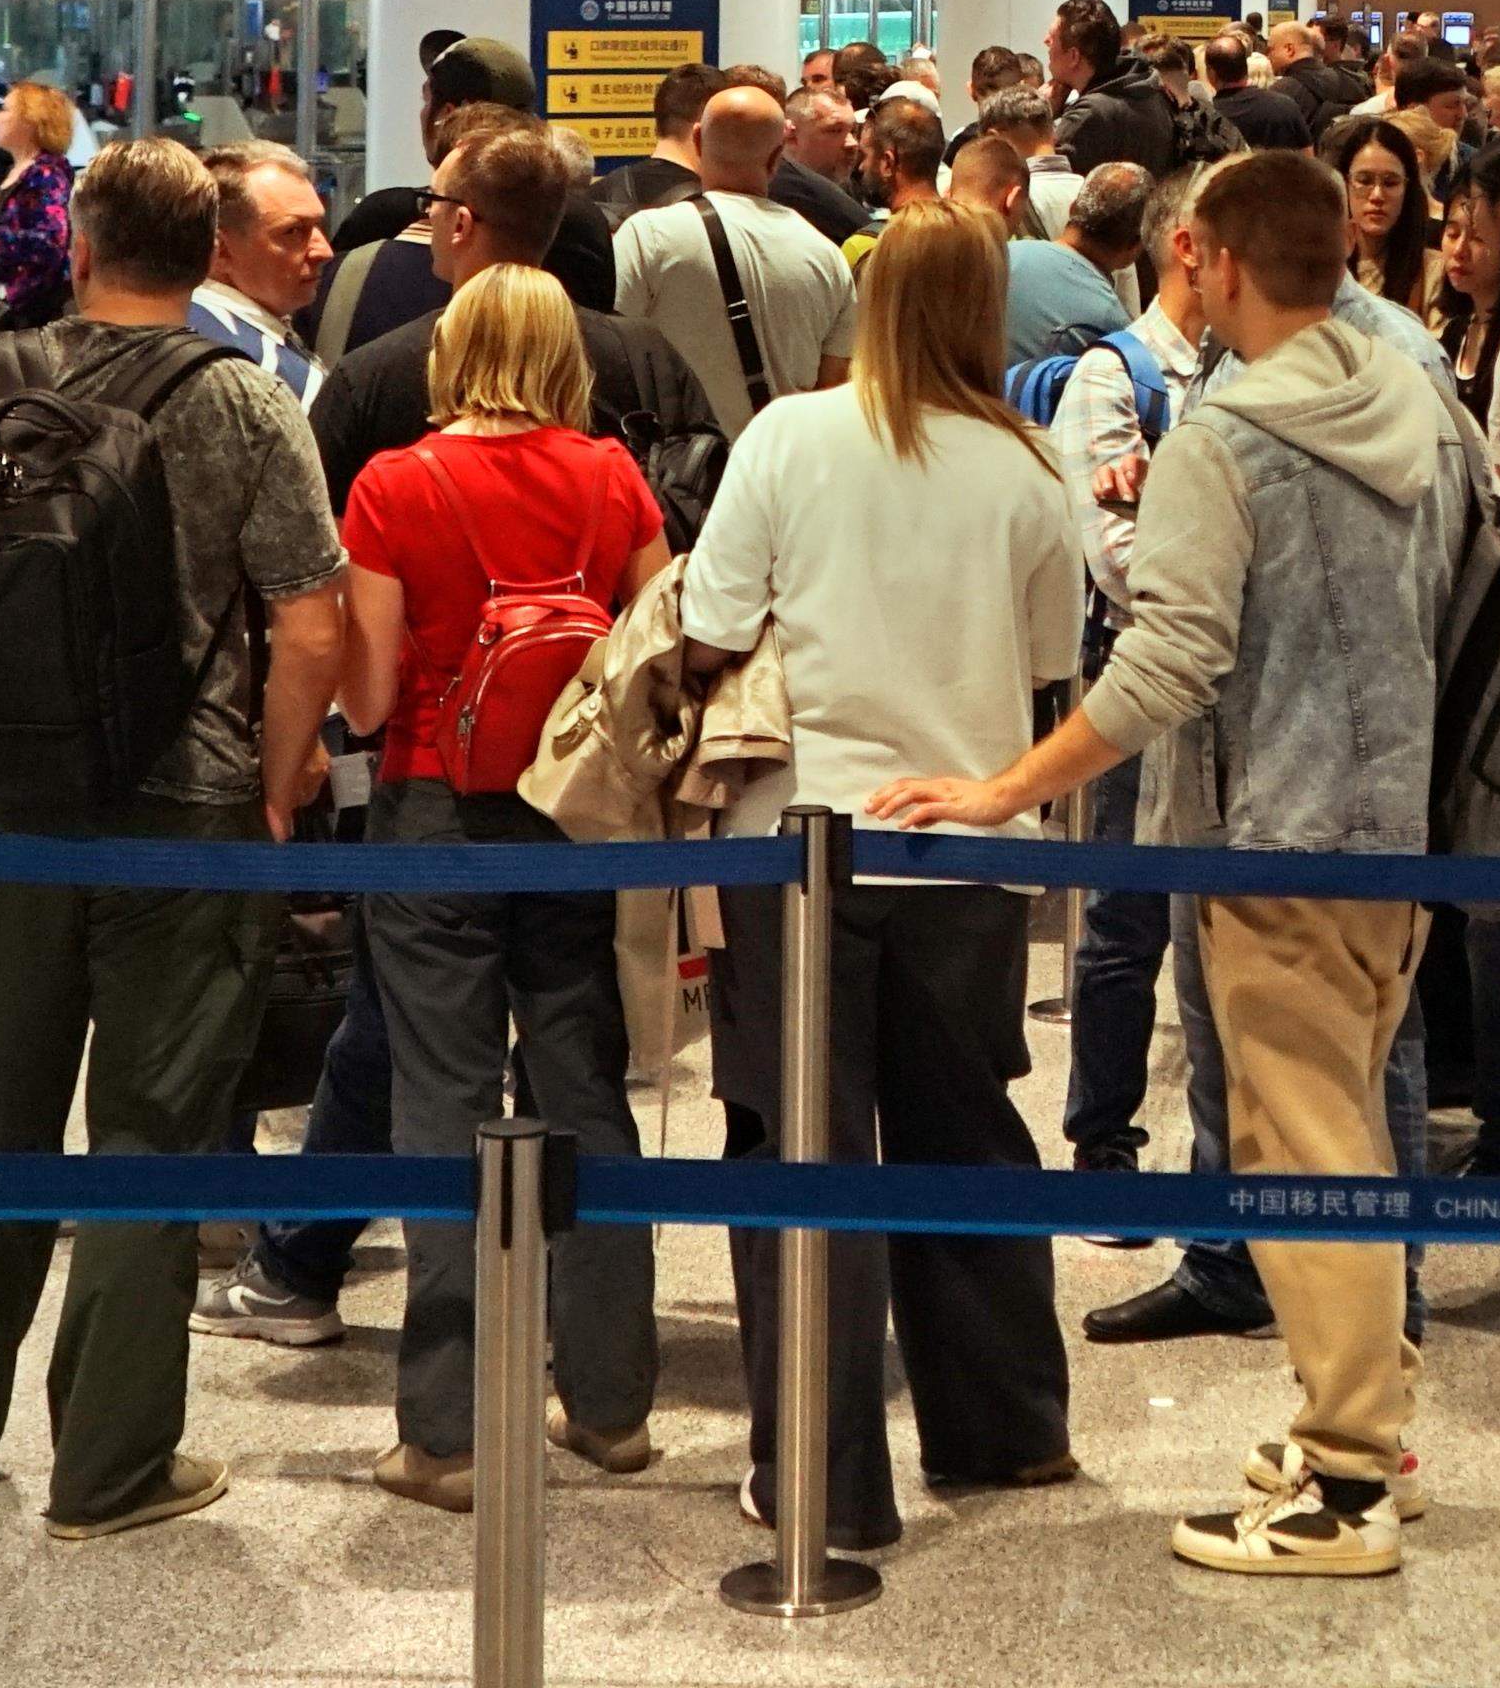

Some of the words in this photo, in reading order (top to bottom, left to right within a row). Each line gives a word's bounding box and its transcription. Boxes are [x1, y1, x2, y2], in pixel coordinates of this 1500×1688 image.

[590, 126, 657, 139] 电子监控区
[1229, 1189, 1411, 1218] 中国移民管理
